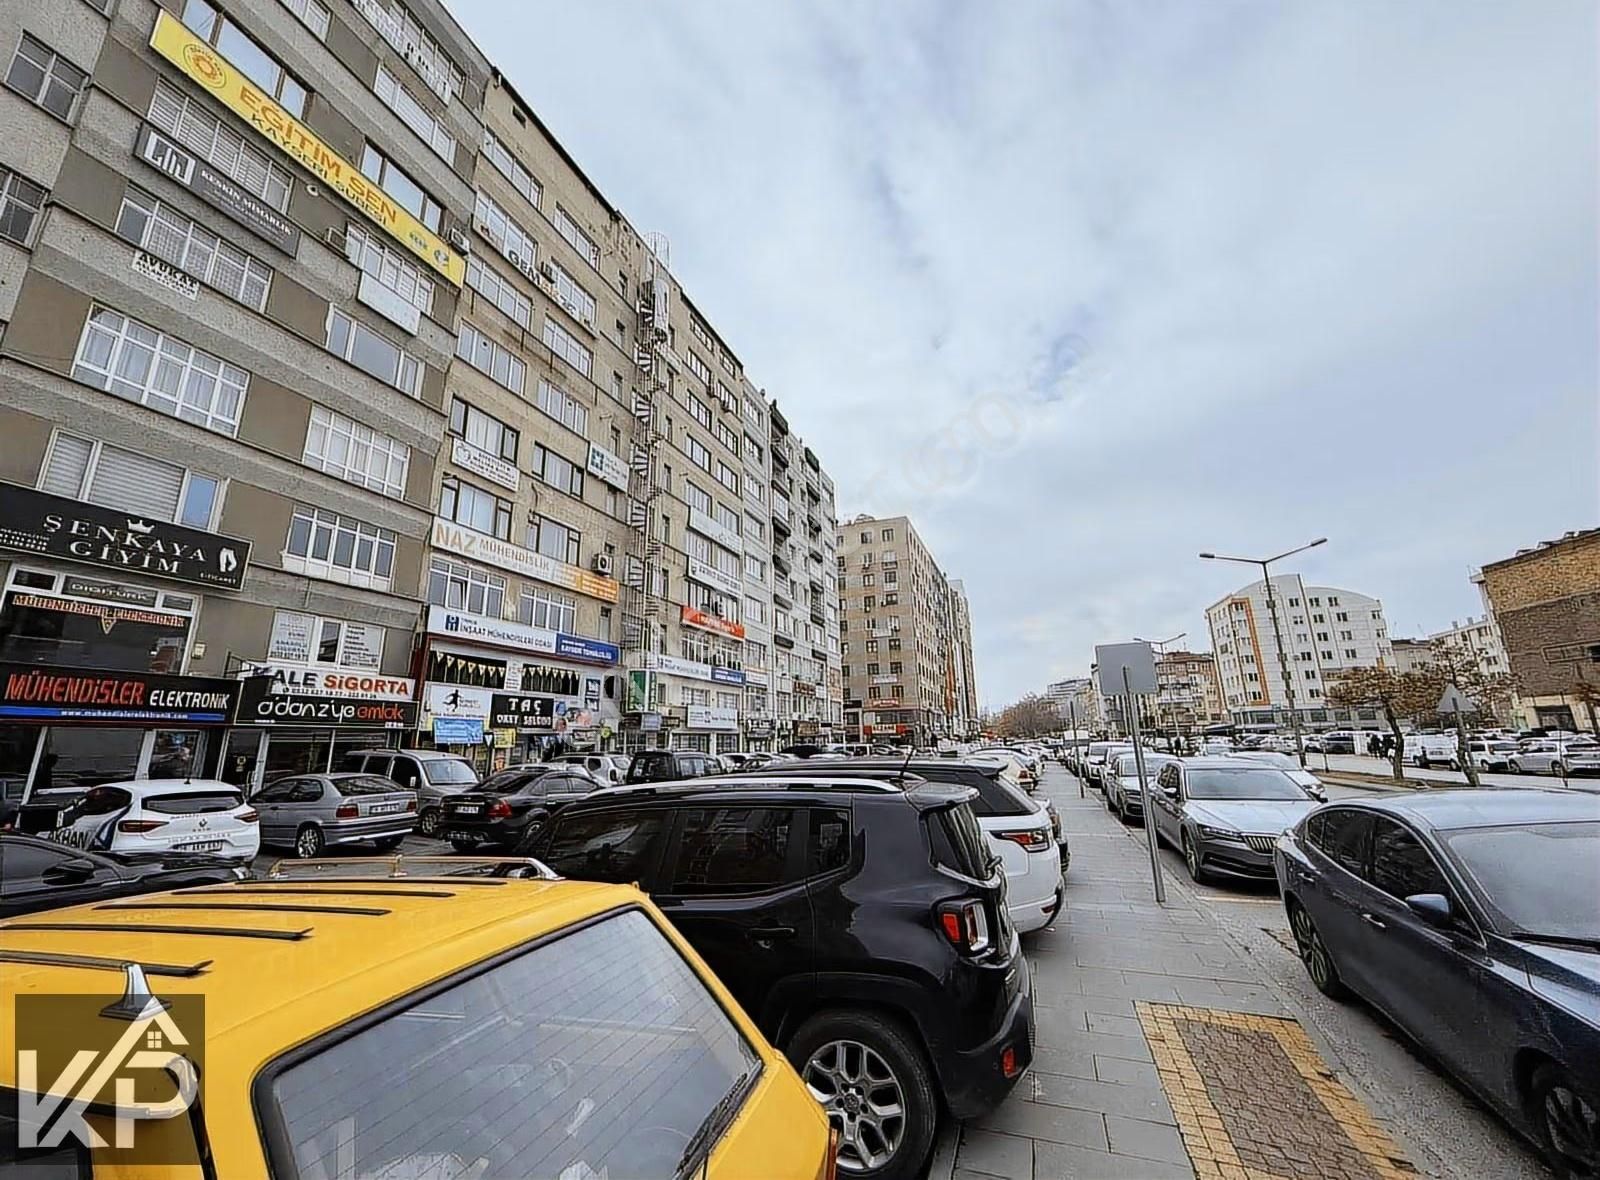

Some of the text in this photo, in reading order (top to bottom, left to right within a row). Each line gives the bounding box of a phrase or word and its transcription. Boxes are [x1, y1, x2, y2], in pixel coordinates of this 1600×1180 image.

[240, 86, 341, 178] EĞİTİM
[348, 175, 397, 224] SEN
[139, 253, 199, 288] AVUKAT
[43, 514, 208, 562] ŞENKAYA
[436, 523, 476, 552] NAZ
[69, 541, 180, 574] GİYİM
[508, 698, 542, 715] TAÇ
